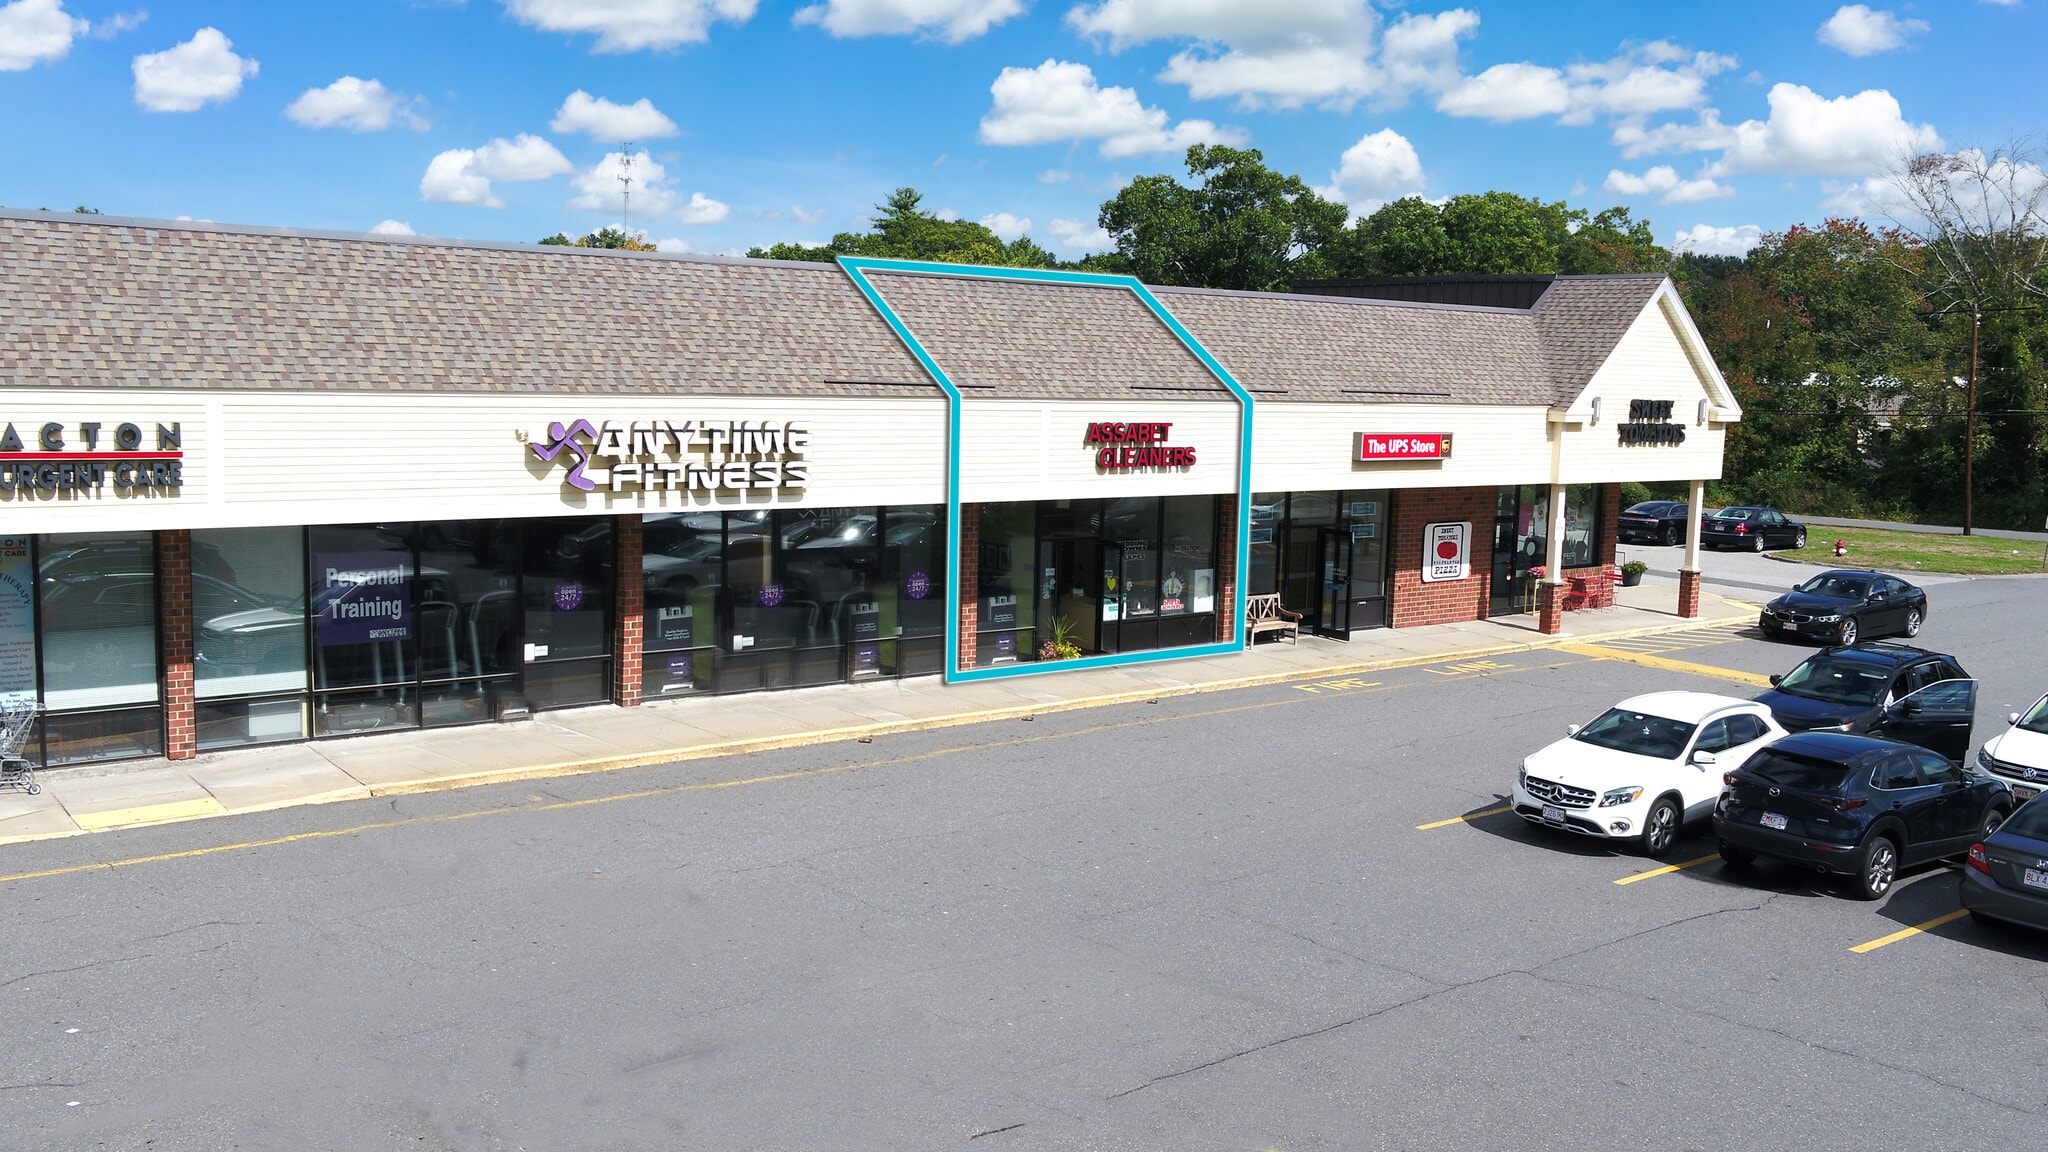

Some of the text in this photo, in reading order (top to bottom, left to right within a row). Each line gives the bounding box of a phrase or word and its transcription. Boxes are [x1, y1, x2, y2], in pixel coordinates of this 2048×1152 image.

[0, 421, 182, 450] ACTON
[598, 420, 812, 457] ANYTIME
[1087, 422, 1173, 443] ASSABET
[1100, 446, 1197, 469] CLEANERS
[1367, 438, 1387, 454] The
[1388, 438, 1409, 453] UPS
[1410, 438, 1436, 453] Store
[0, 461, 183, 490] URGENT CARE
[610, 461, 812, 492] FITNESS
[325, 564, 404, 588] Personal
[1434, 565, 1458, 575] PIZZA
[328, 596, 402, 620] Training
[1290, 660, 1514, 694] FIRE LANE
